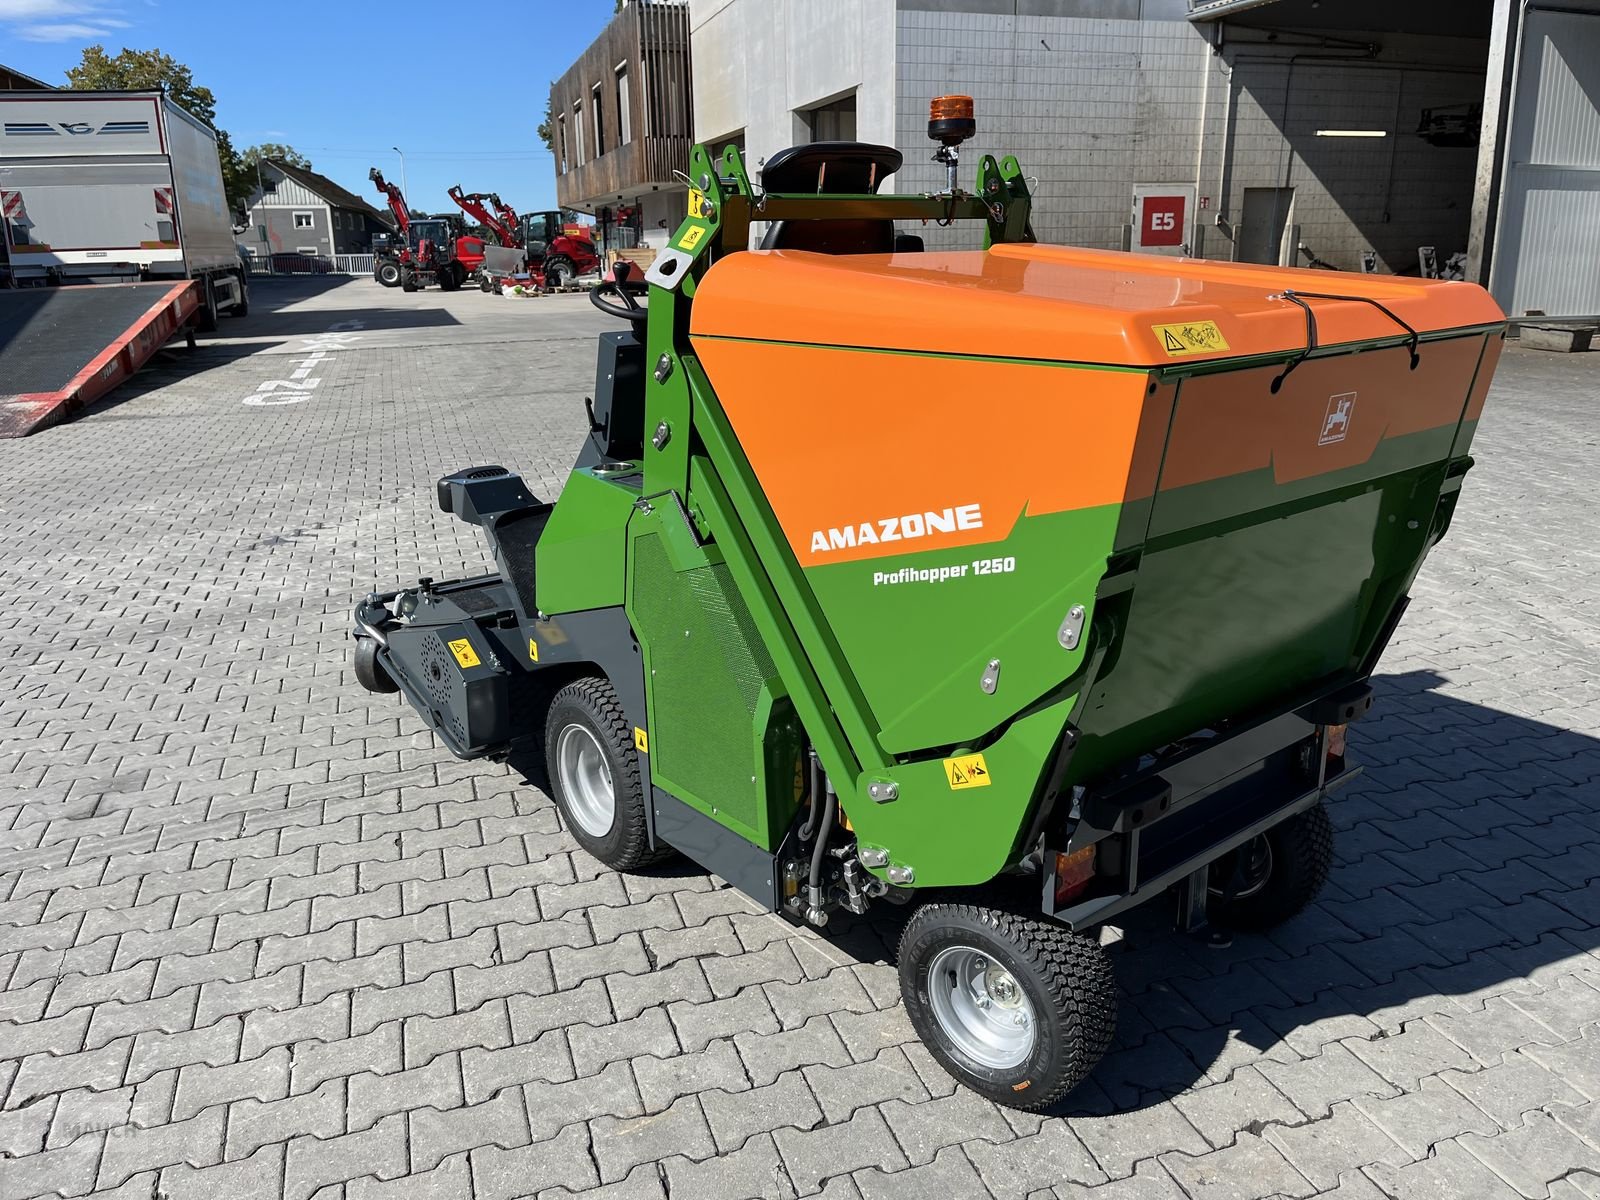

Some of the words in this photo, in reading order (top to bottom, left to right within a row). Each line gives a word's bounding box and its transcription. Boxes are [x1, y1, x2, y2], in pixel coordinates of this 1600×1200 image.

[1151, 212, 1175, 231] E5
[810, 503, 983, 553] AMAZONE
[873, 563, 969, 586] Profihopper
[971, 556, 1016, 576] 1250
